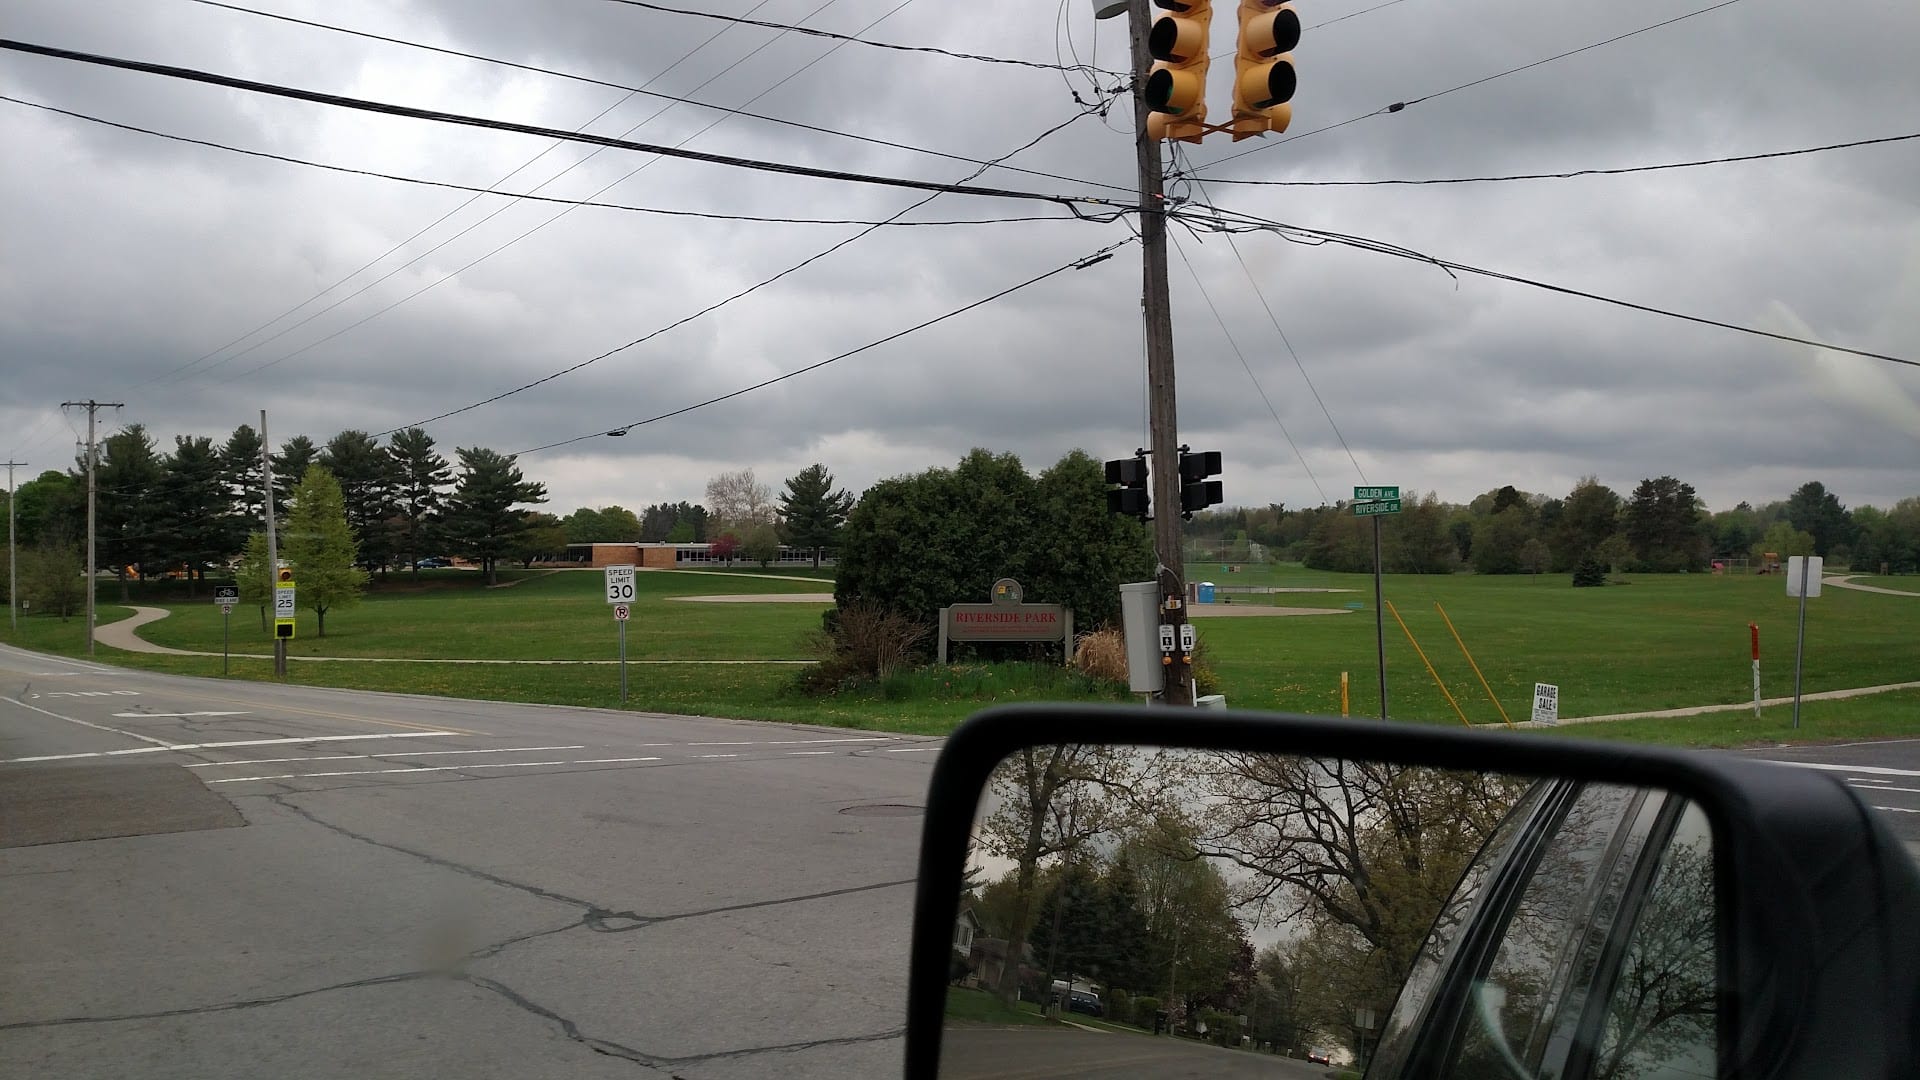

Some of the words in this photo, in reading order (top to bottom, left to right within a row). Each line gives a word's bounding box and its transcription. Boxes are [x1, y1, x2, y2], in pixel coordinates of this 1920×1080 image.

[1358, 488, 1382, 498] GOLDEN
[1355, 502, 1389, 514] RIVERSIDE
[610, 576, 631, 584] LIMIT
[609, 584, 633, 599] 30
[277, 599, 293, 608] 25
[956, 612, 1020, 623] RIVERSIDE
[1025, 612, 1057, 623] PARK
[1536, 684, 1557, 699] GARAGE
[1538, 697, 1553, 711] SALE
